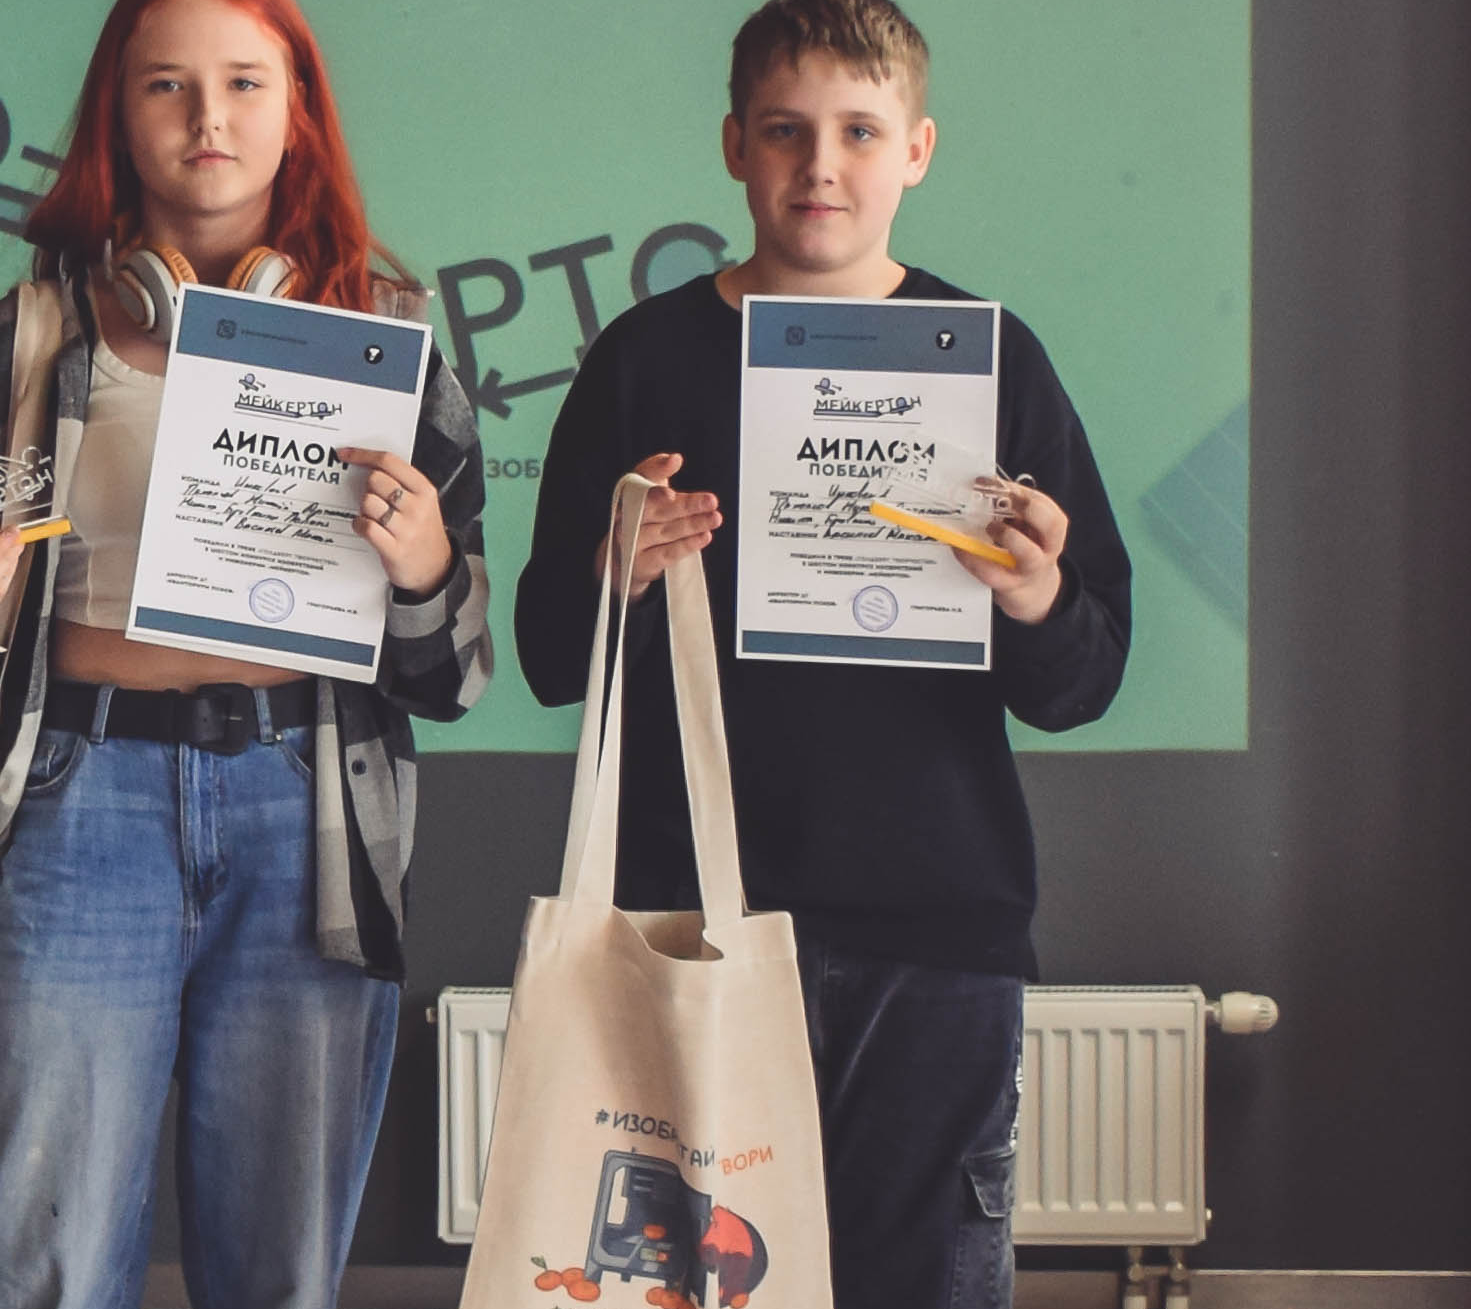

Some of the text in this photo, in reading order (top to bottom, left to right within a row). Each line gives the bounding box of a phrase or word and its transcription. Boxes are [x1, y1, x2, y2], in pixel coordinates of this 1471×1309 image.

[213, 428, 349, 470] ДИПЛОМ
[224, 454, 340, 484] ПОБЕДИТЕЛЯ
[809, 463, 928, 481] ПОБЕДИ
